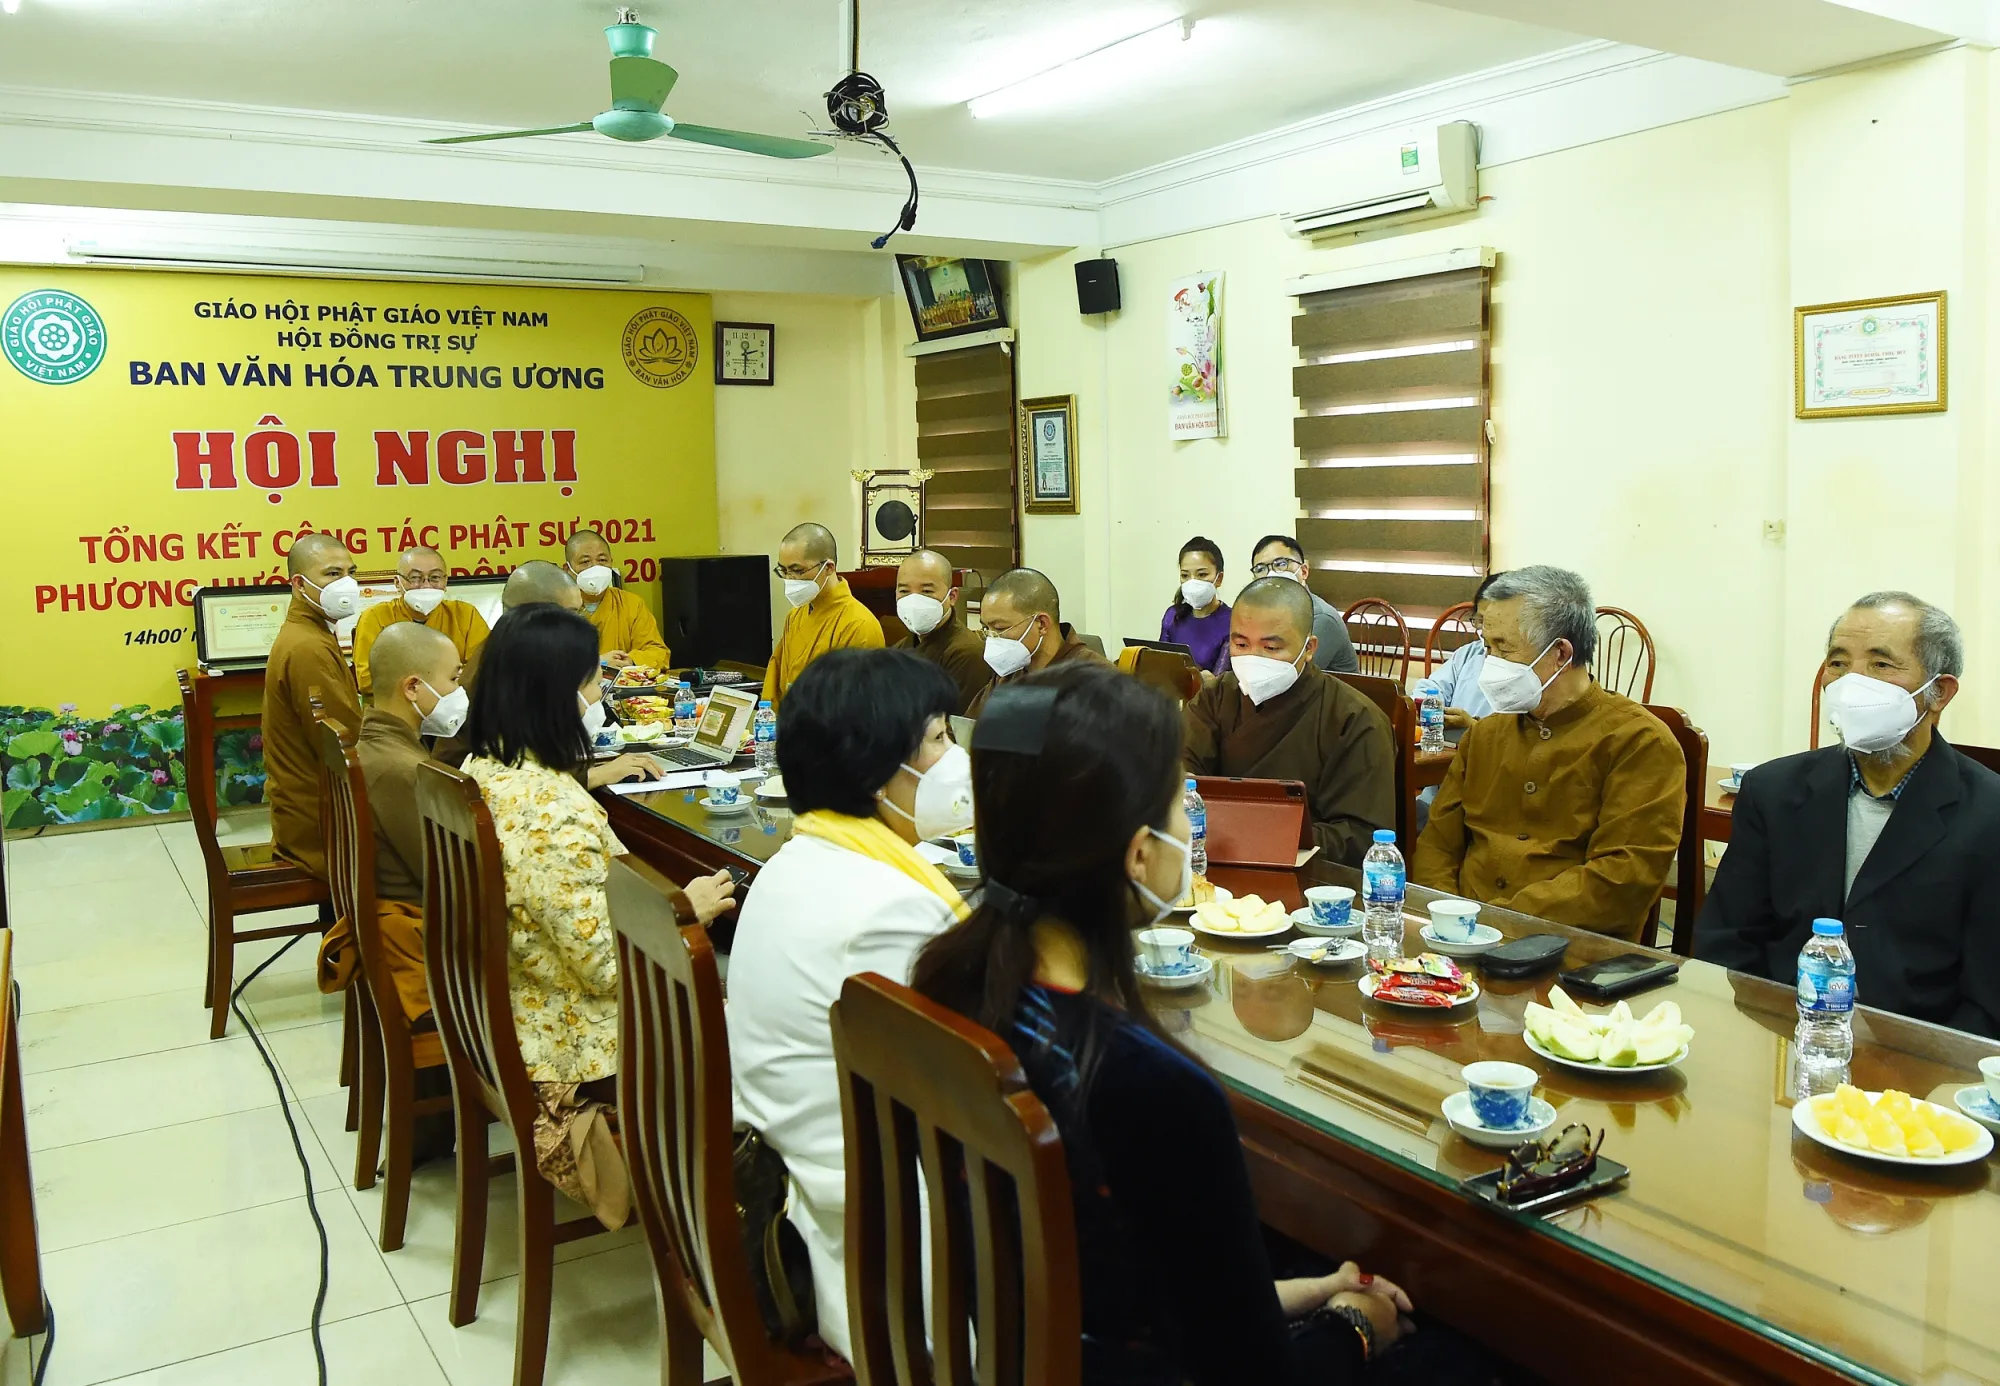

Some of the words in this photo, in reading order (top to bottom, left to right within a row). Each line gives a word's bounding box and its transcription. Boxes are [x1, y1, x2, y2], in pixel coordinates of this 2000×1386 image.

[194, 297, 257, 319] GIÁO
[265, 300, 310, 325] HỘI
[318, 302, 377, 326] PHẬT
[384, 303, 440, 325] GIÁO
[447, 305, 496, 330] VIỆT
[502, 311, 548, 328] NAM
[277, 327, 322, 352] HỘI
[329, 326, 396, 350] ĐỒNG
[402, 334, 441, 354] TRỊ
[447, 333, 478, 355] SỰ
[57, 360, 87, 377] NAM
[129, 361, 206, 386] BAN
[218, 355, 292, 387] VĂN
[304, 355, 378, 388] HÓA
[387, 364, 501, 388] TRUNG
[512, 363, 605, 389] ƯƠNG
[172, 414, 339, 504] HỘI
[374, 429, 578, 497] NGHỊ
[79, 525, 185, 564] TỔNG
[197, 522, 262, 560] KẾT
[377, 517, 440, 552] TÁC
[450, 515, 530, 555] PHẬT
[35, 576, 198, 613] PHƯƠNG
